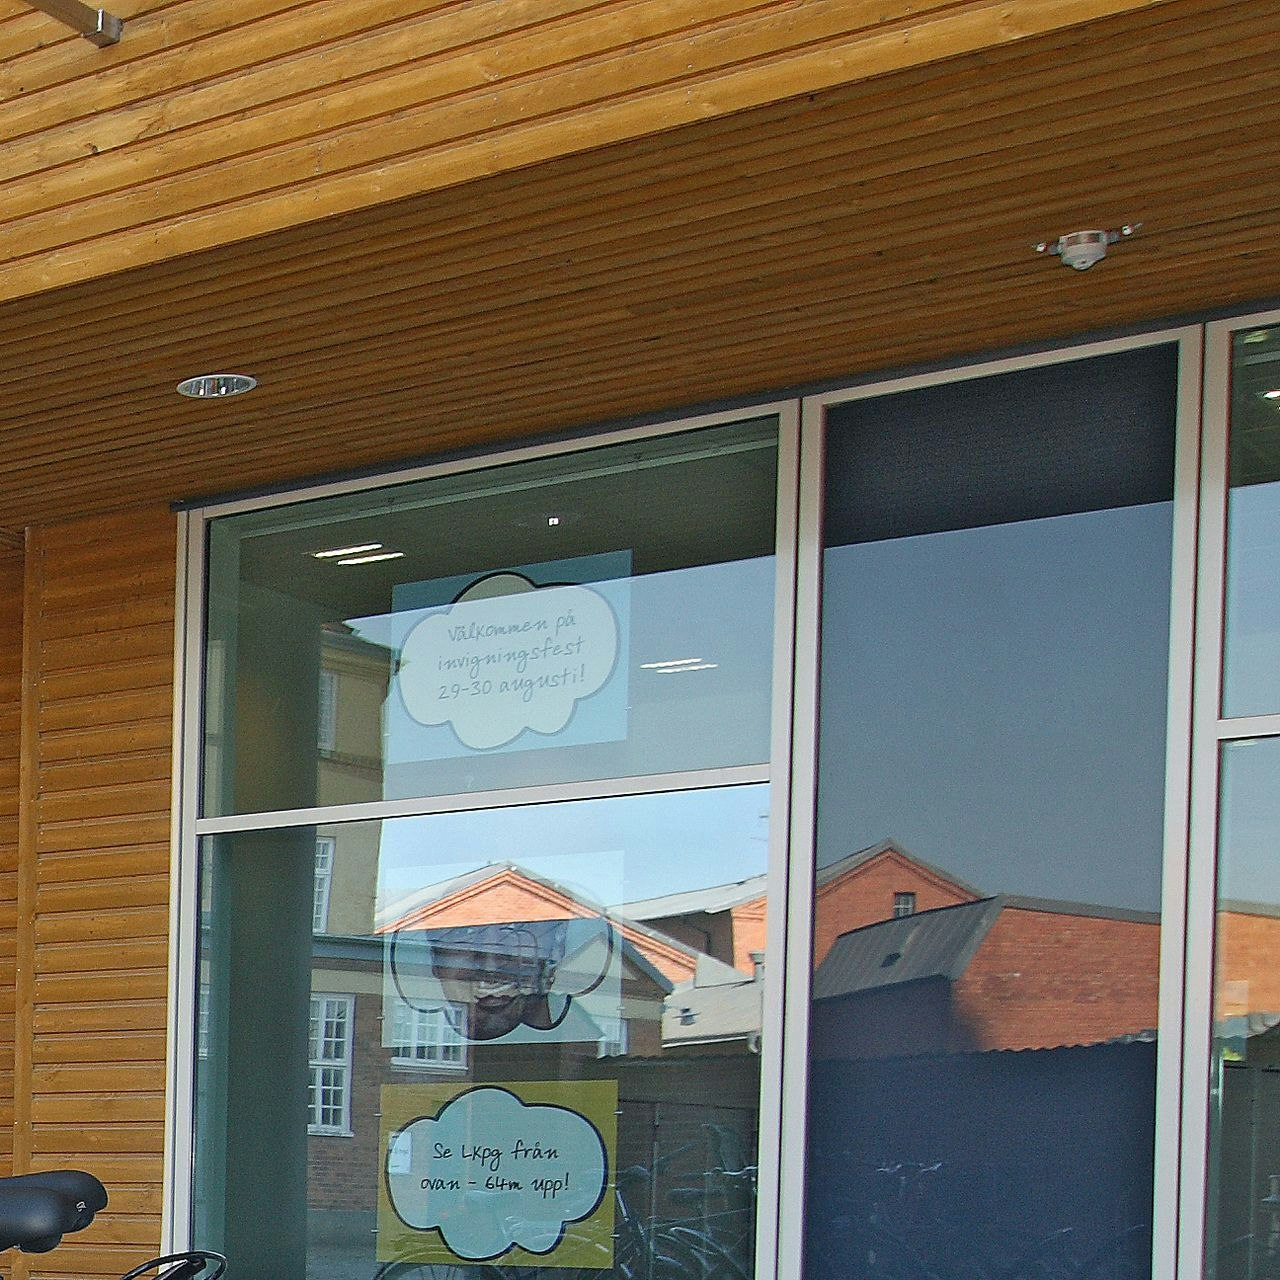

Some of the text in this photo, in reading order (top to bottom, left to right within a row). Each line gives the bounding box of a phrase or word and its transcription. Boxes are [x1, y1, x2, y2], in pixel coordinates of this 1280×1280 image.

[448, 609, 577, 642] Välkommen på
[438, 636, 586, 680] invigningsfest
[437, 663, 586, 703] 29-30 augusti!
[432, 1142, 453, 1160] Se
[510, 1139, 559, 1160] från
[420, 1178, 461, 1191] ovan
[484, 1175, 524, 1191] 64m
[531, 1171, 570, 1199] upp!
